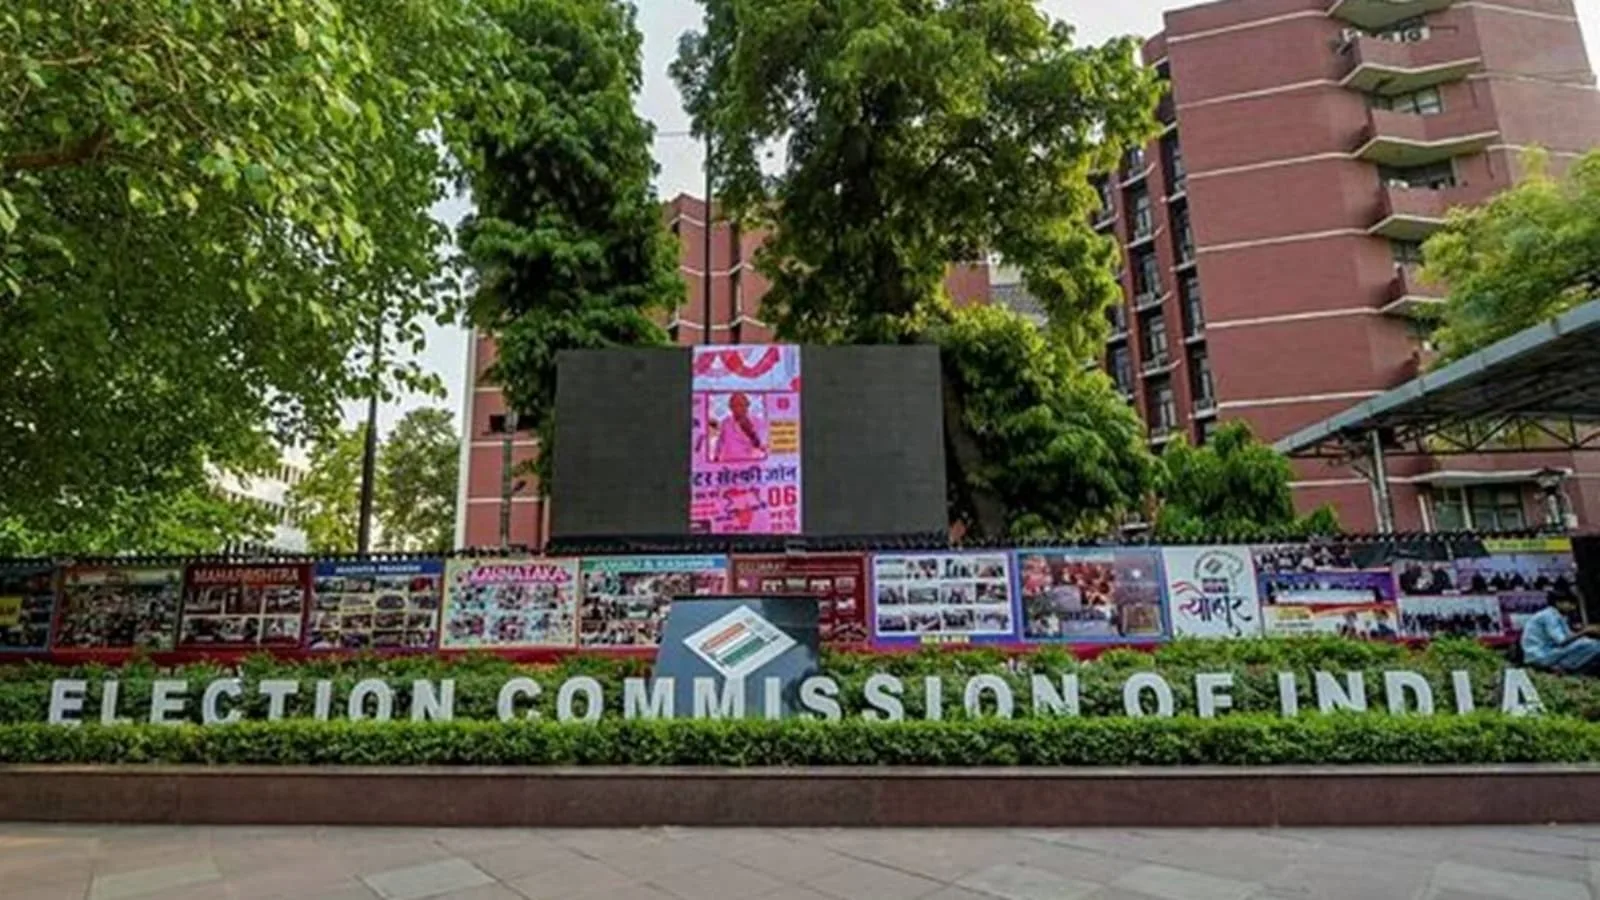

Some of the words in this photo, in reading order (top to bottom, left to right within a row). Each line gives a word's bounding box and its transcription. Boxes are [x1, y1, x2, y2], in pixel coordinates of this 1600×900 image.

[767, 485, 797, 508] 06
[193, 567, 300, 582] MAHARASHTRA
[470, 565, 568, 584] KARNATAKA
[48, 678, 455, 726] ELECTION
[497, 673, 1080, 723] COMMISSION
[1122, 671, 1234, 719] OF
[1277, 667, 1547, 718] INDIA
